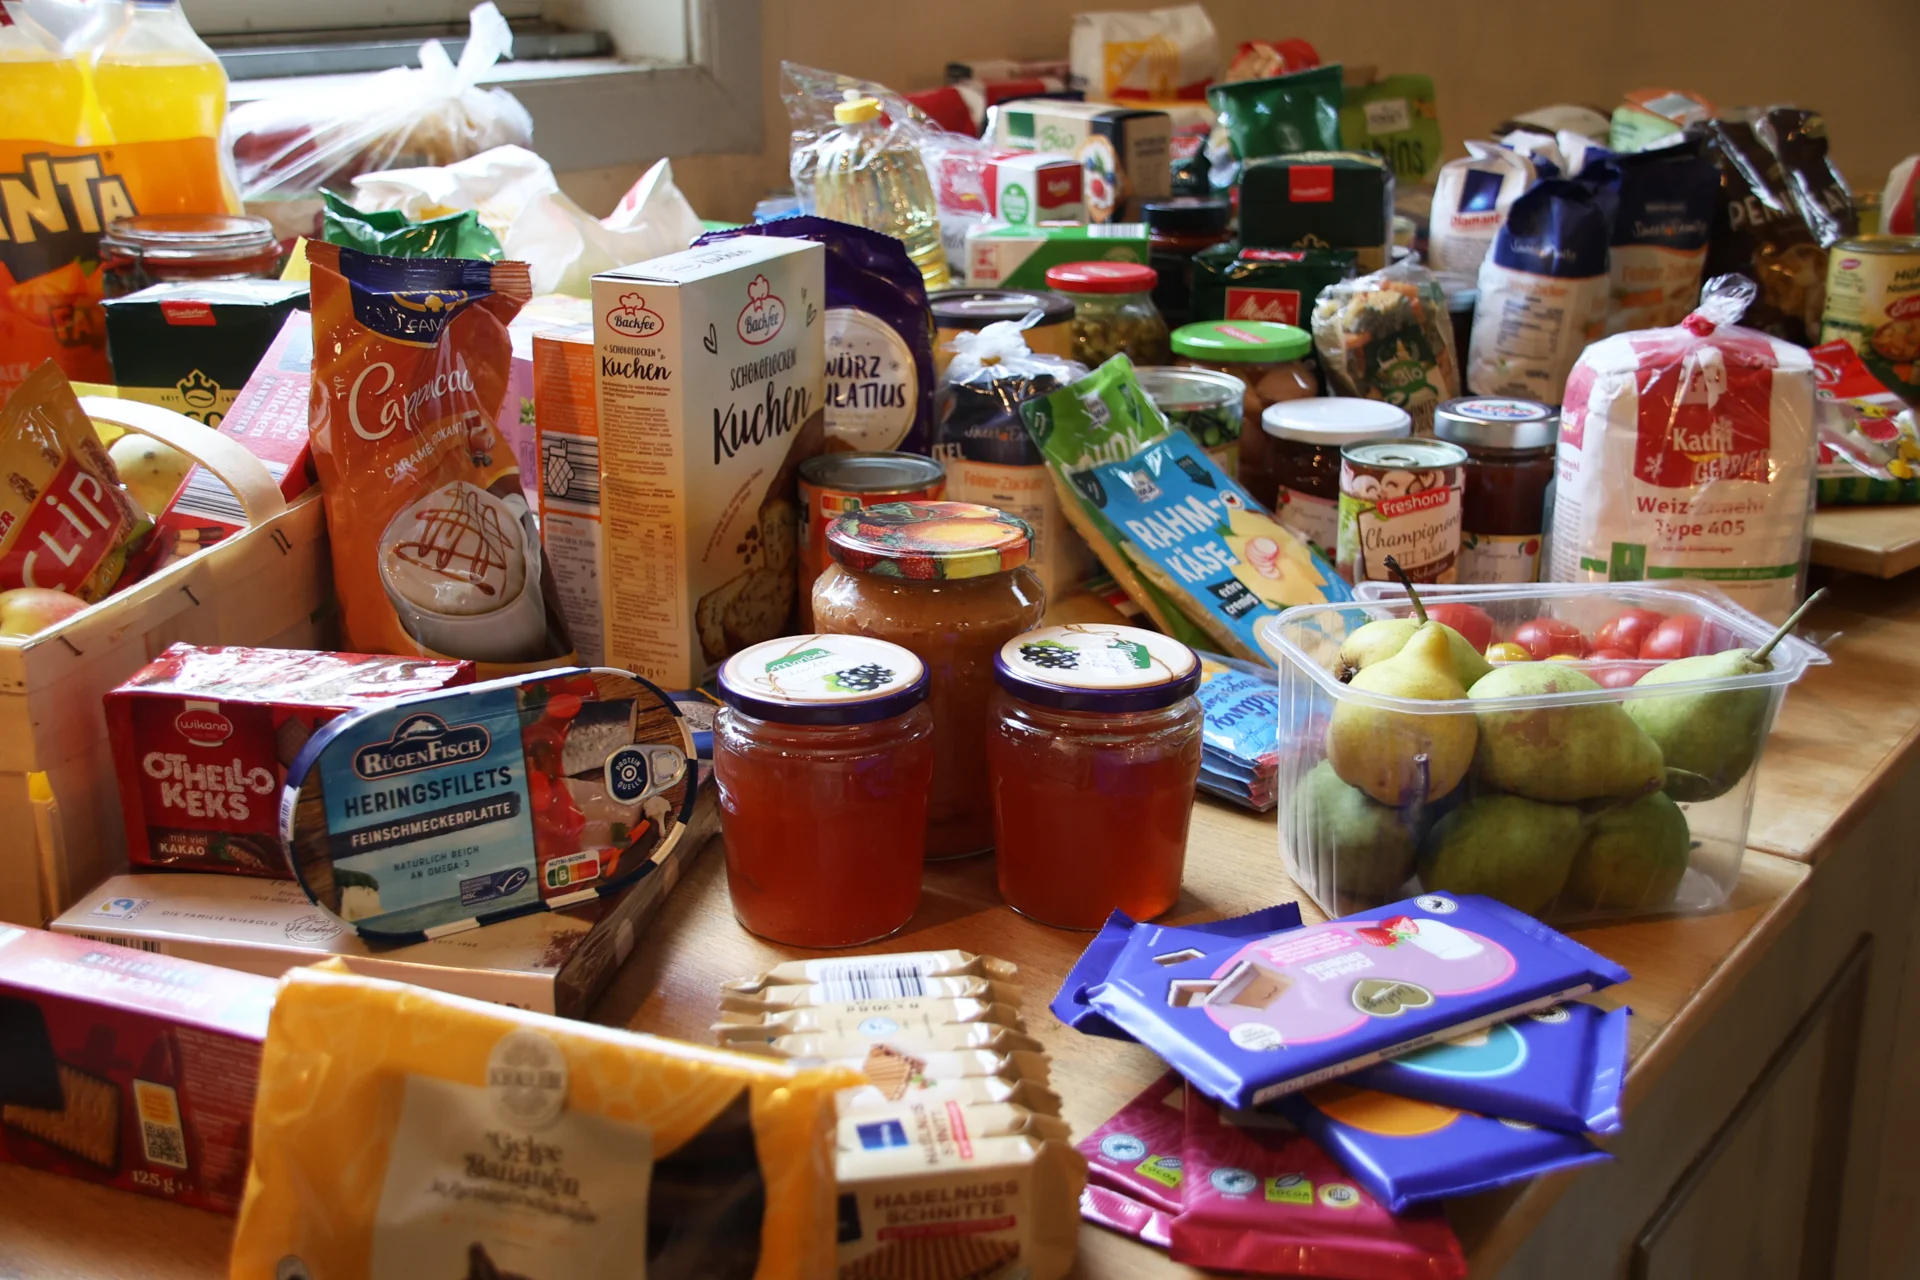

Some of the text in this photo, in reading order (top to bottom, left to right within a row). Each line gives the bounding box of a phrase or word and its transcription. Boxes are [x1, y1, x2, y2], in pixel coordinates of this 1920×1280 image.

[0, 158, 136, 244] NTA
[1452, 213, 1501, 229] Diamant
[614, 315, 655, 333] Backfee
[745, 304, 780, 336] Backfee
[609, 344, 656, 357] SCHOKOFLOCKEN
[602, 356, 672, 380] Kuchen
[730, 347, 798, 391] SCHOKOFLOCKEN
[231, 375, 278, 434] ZARTBITTER
[714, 381, 812, 465] Kuchen
[1382, 490, 1446, 516] Freshona
[1125, 495, 1222, 550] RAHM-
[1707, 520, 1745, 536] 405
[1165, 540, 1242, 583] KÄSE
[1218, 580, 1243, 598] extra
[1225, 592, 1260, 616] cremig
[772, 649, 830, 671] Maribel
[180, 720, 228, 731] wikana
[143, 752, 275, 795] OTHELLO
[615, 757, 642, 771] PROTEIN
[345, 766, 513, 819] HERINGSFILETS
[617, 777, 643, 790] QUELLE
[161, 781, 250, 821] KEKS
[352, 802, 512, 848] FEINSCHMECKERPLATTE
[170, 834, 208, 845] mit viel
[160, 843, 206, 856] KAKAO
[451, 845, 480, 860] REICH
[549, 854, 587, 868] NUTRI-SCORE
[411, 871, 424, 880] AN
[559, 870, 567, 881] B
[462, 891, 477, 900] MSC
[184, 912, 226, 922] FAMILIE
[229, 917, 279, 927] WIEBOLD
[132, 1169, 160, 1187] 125
[1142, 1163, 1177, 1183] COCOA
[874, 1179, 1020, 1209] HASELNUSS
[1268, 1188, 1310, 1198] COCOA
[886, 1200, 1006, 1225] SCHNITTE
